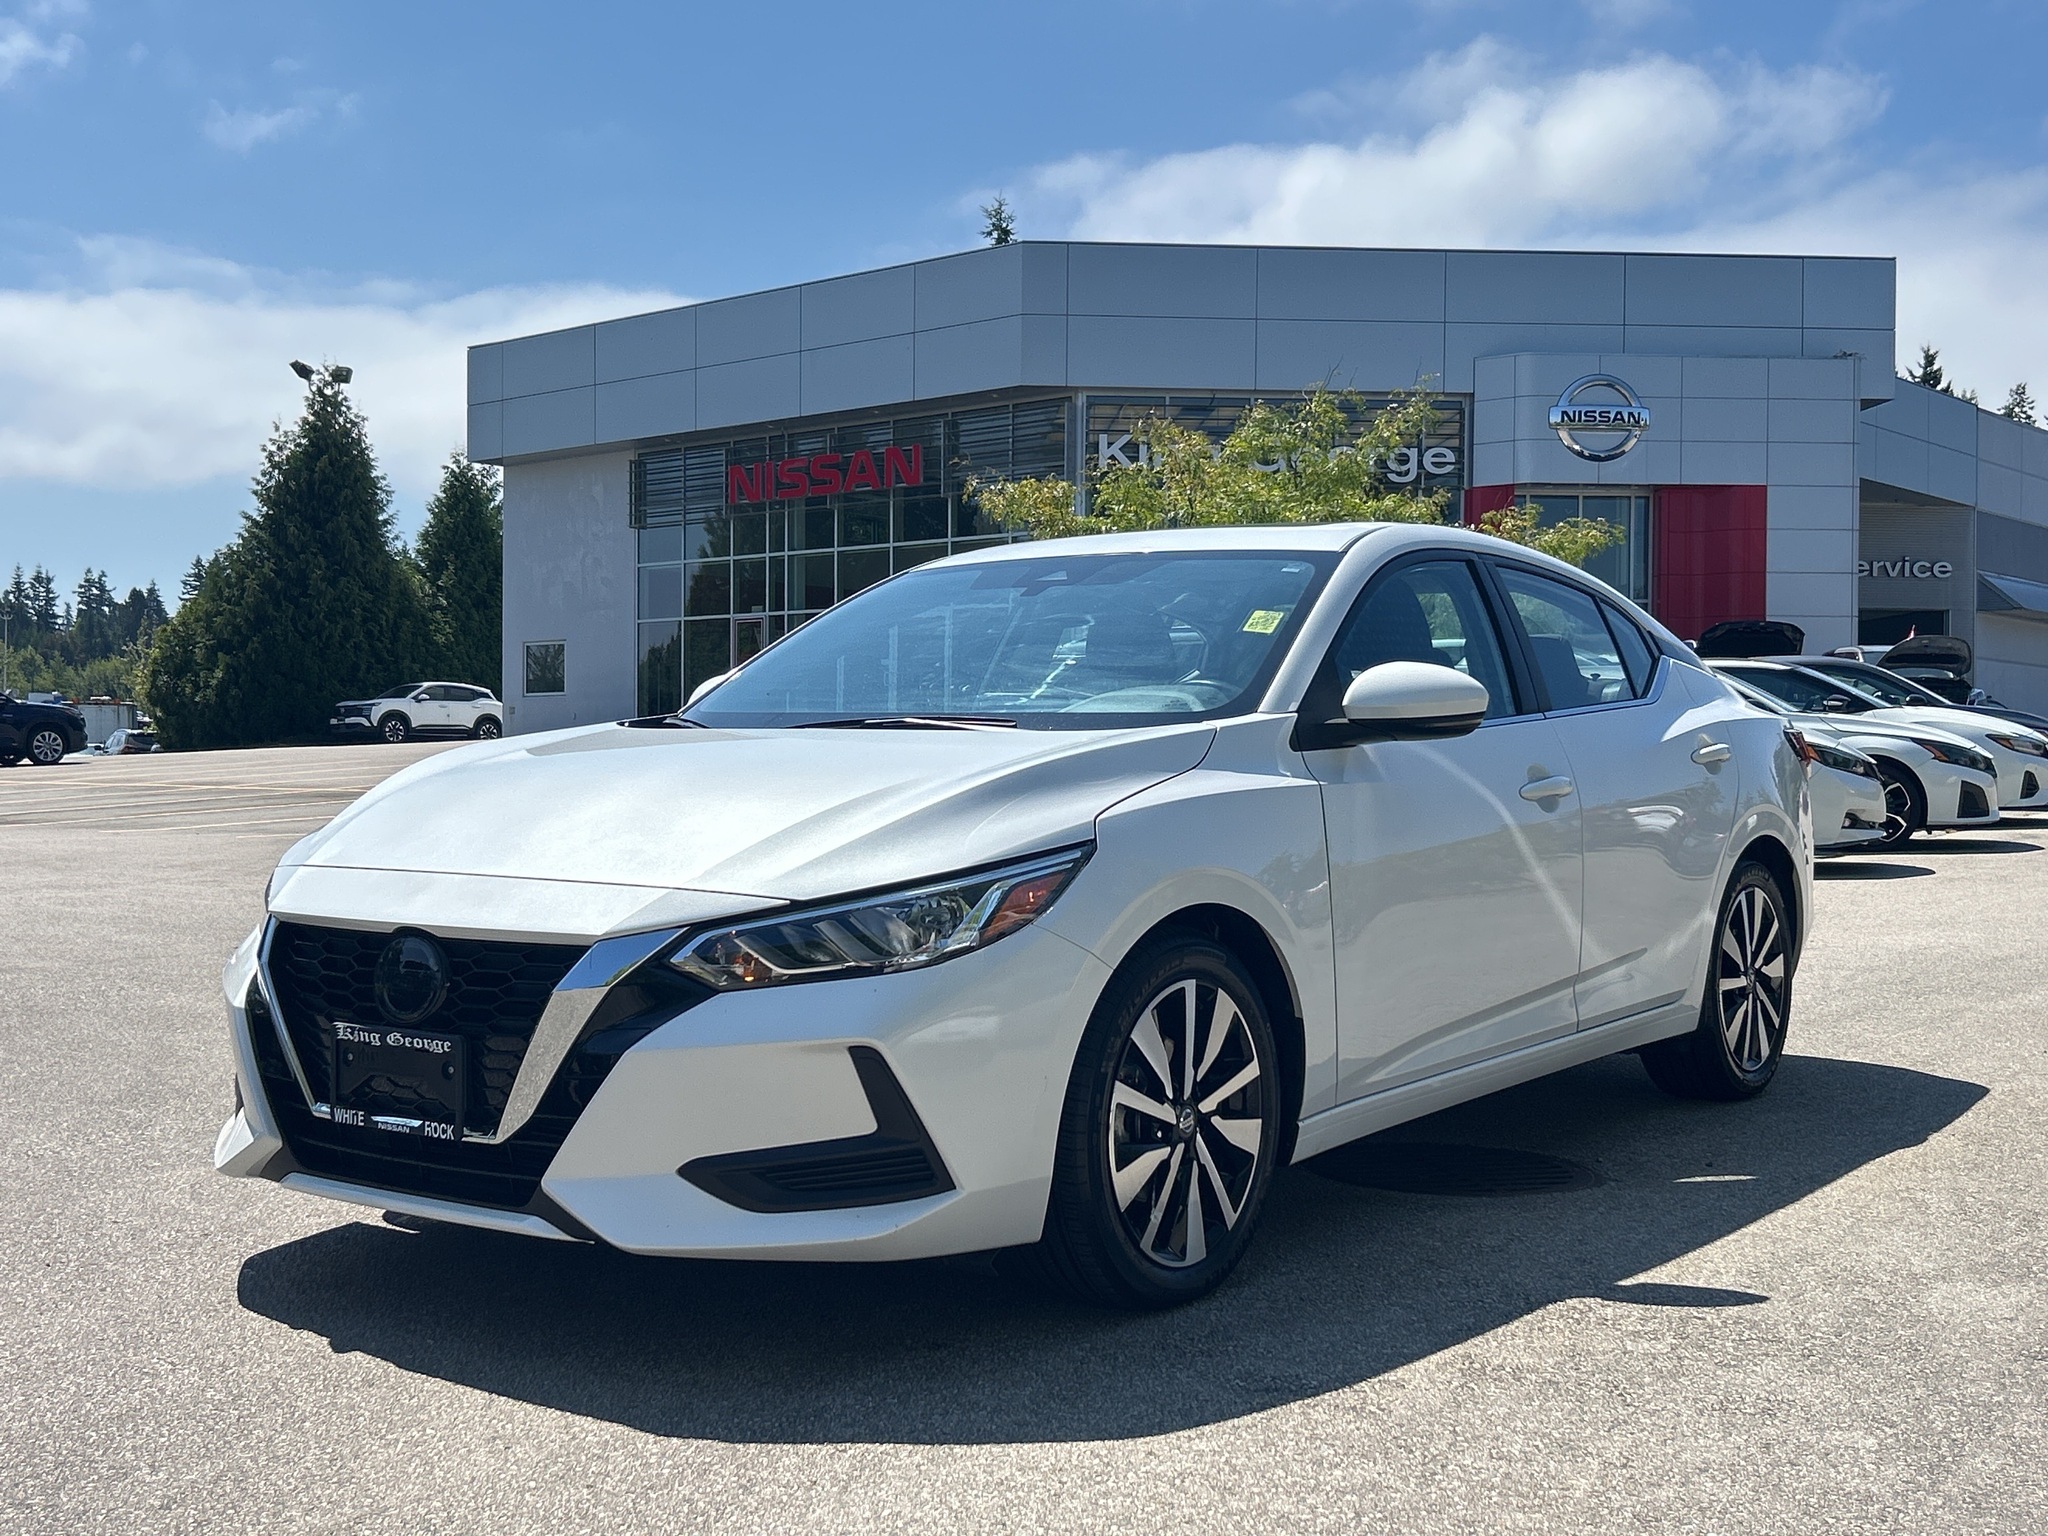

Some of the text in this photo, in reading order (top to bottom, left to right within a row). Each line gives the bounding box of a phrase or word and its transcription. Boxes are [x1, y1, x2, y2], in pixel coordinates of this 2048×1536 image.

[1560, 409, 1641, 425] NISSAN
[728, 443, 923, 505] NISSAN
[1858, 556, 1953, 578] ervice
[335, 1023, 452, 1054] King George
[333, 1107, 455, 1140] WHITE ROCK
[377, 1122, 410, 1134] NISSAN
